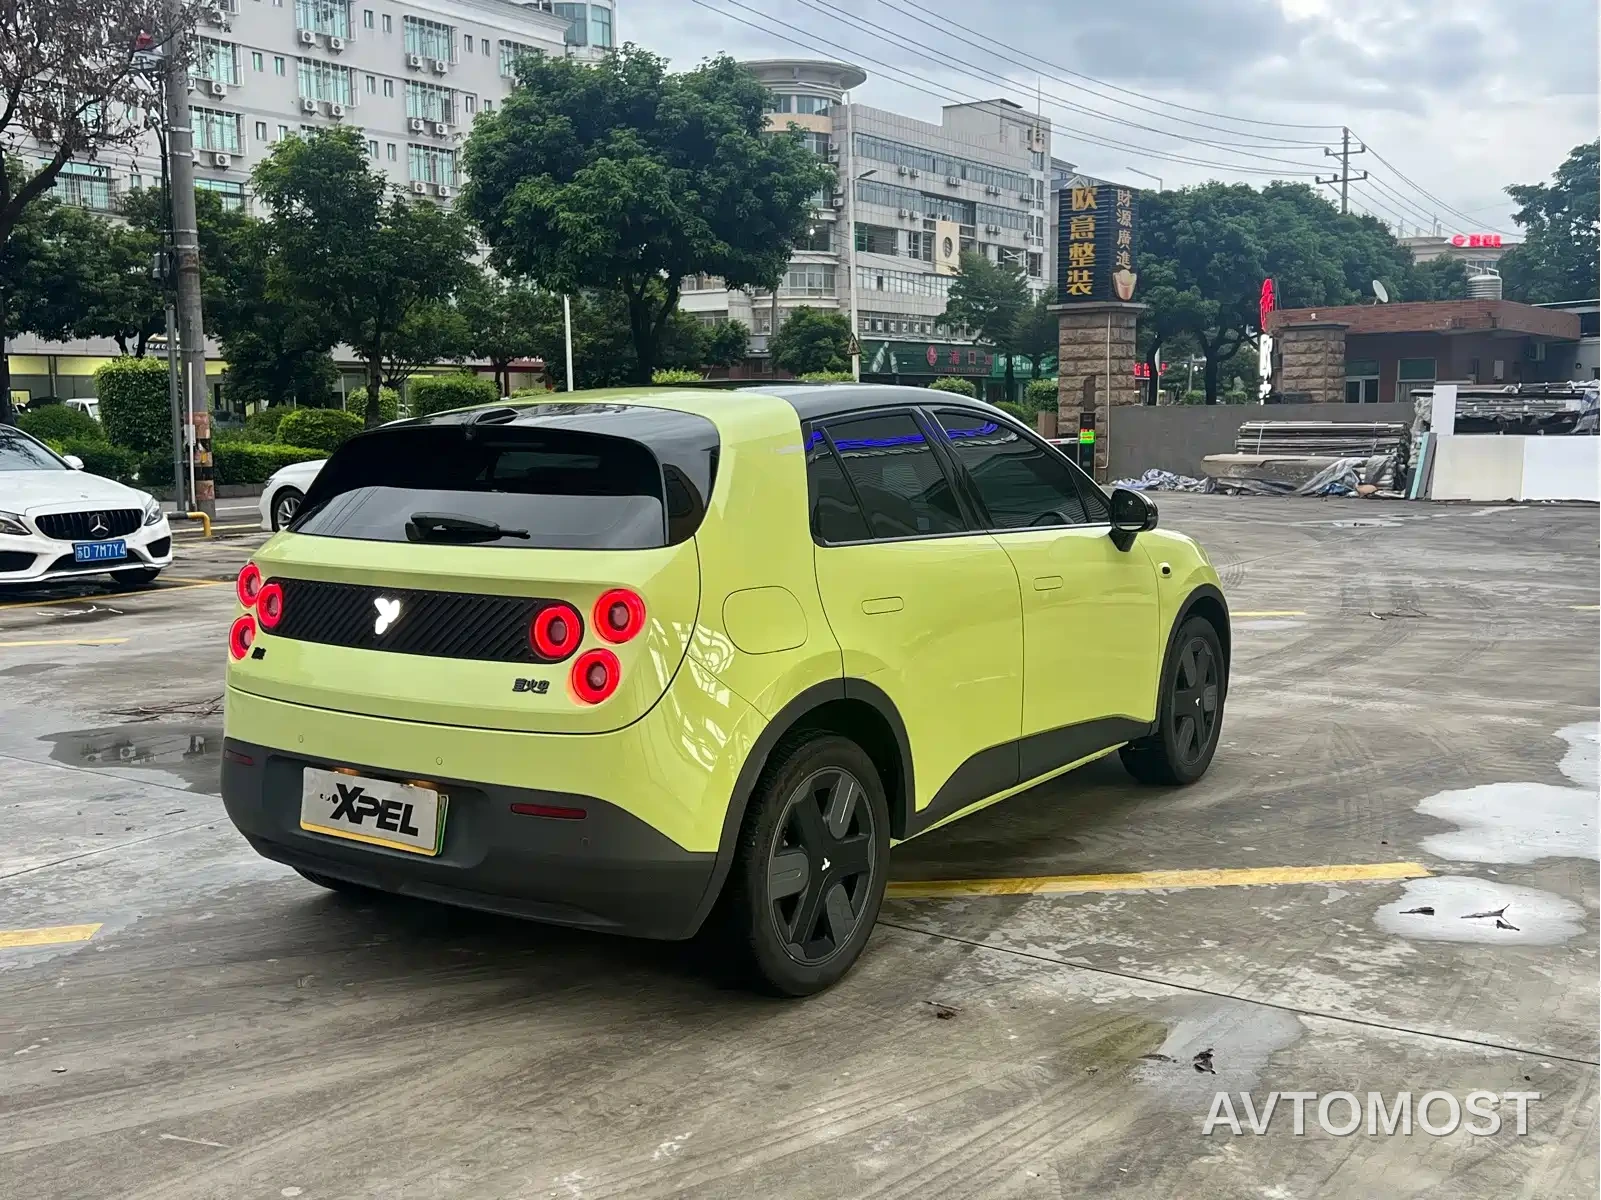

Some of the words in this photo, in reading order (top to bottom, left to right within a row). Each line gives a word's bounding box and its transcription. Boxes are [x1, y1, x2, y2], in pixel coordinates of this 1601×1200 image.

[1066, 187, 1098, 295] 欧意整装
[1116, 189, 1132, 270] 財源廣進
[329, 783, 419, 837] XPEL
